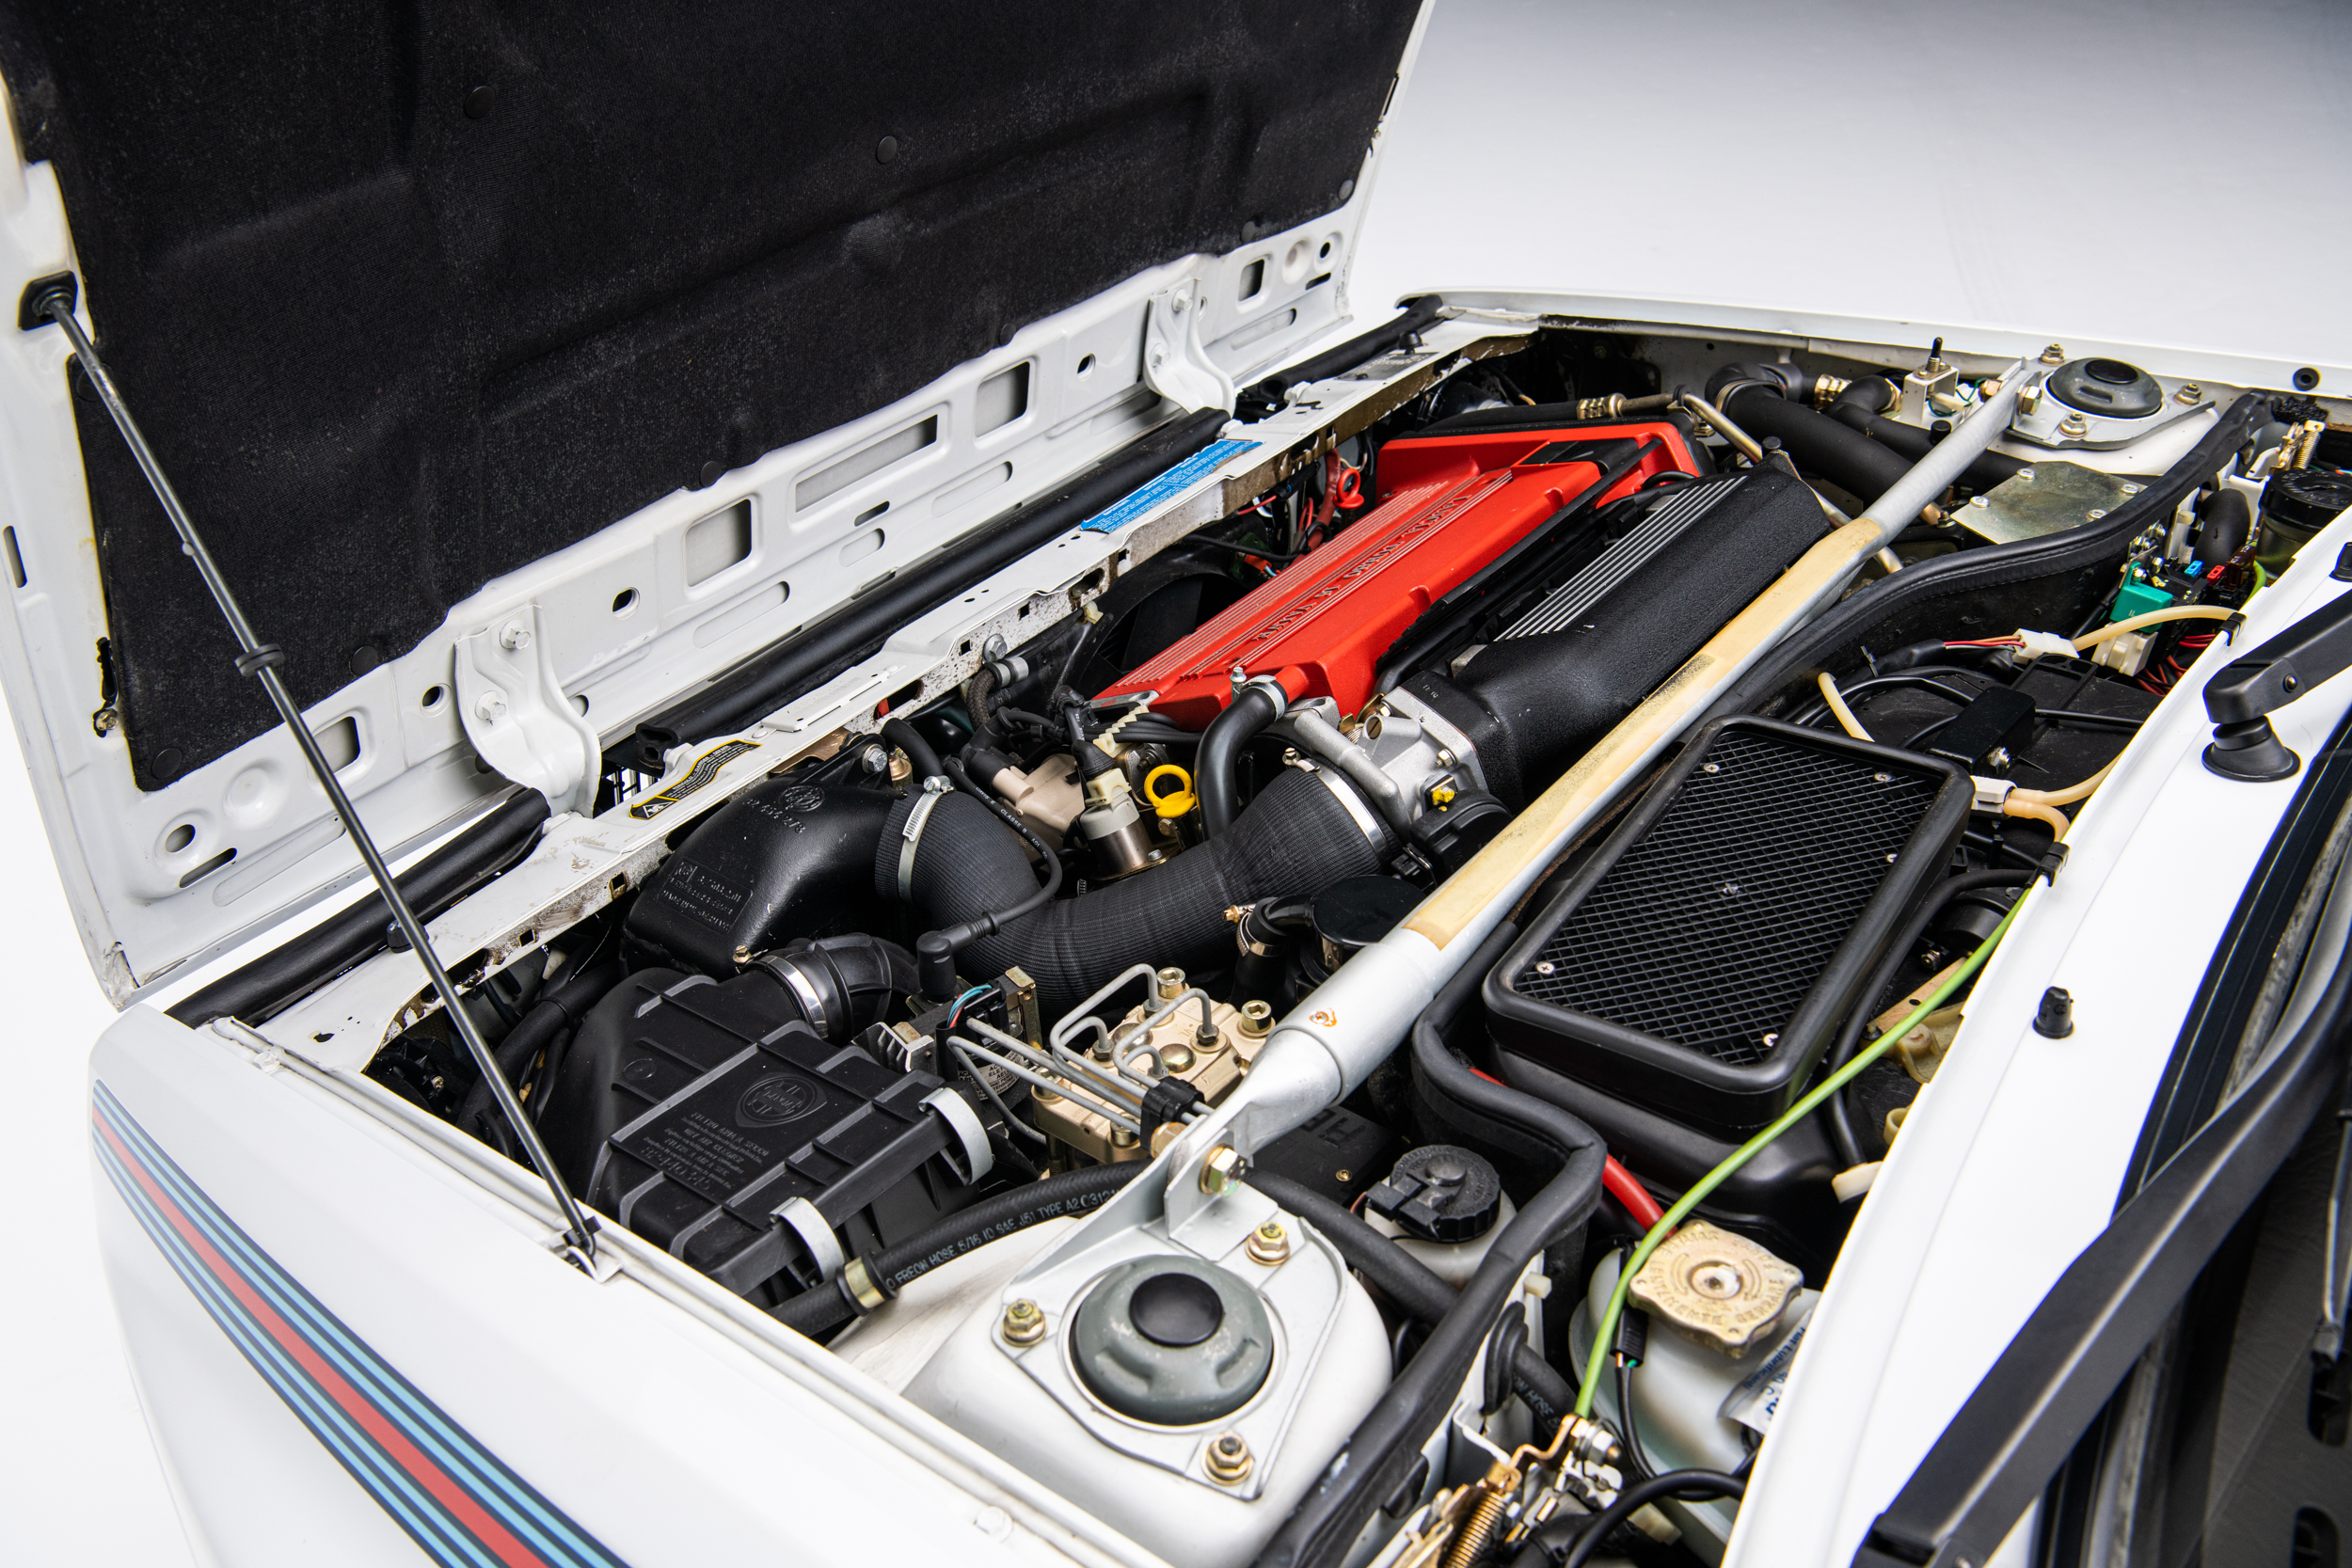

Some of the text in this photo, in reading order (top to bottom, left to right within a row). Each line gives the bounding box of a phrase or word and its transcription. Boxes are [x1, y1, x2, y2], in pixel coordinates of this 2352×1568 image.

[1402, 495, 1472, 538] LANCIA
[1343, 541, 1405, 578] TURBO
[1314, 585, 1342, 598] 16
[1000, 808, 1022, 828] CLASSE
[684, 1129, 744, 1164] DRY AIR CLEANER
[691, 1112, 719, 1129] FILTRO
[718, 1128, 737, 1140] ARIA
[743, 1140, 770, 1157] SECCO
[664, 1138, 689, 1153] FILTRE
[695, 1156, 709, 1164] AIR
[715, 1166, 730, 1176] SEC
[895, 1259, 929, 1283] FREON
[930, 1244, 958, 1265] HOSE
[957, 1233, 982, 1251] 5/16
[982, 1227, 995, 1241] ID
[995, 1218, 1017, 1235] SAE
[1019, 1212, 1036, 1227] J51
[1037, 1202, 1062, 1221] TYPE
